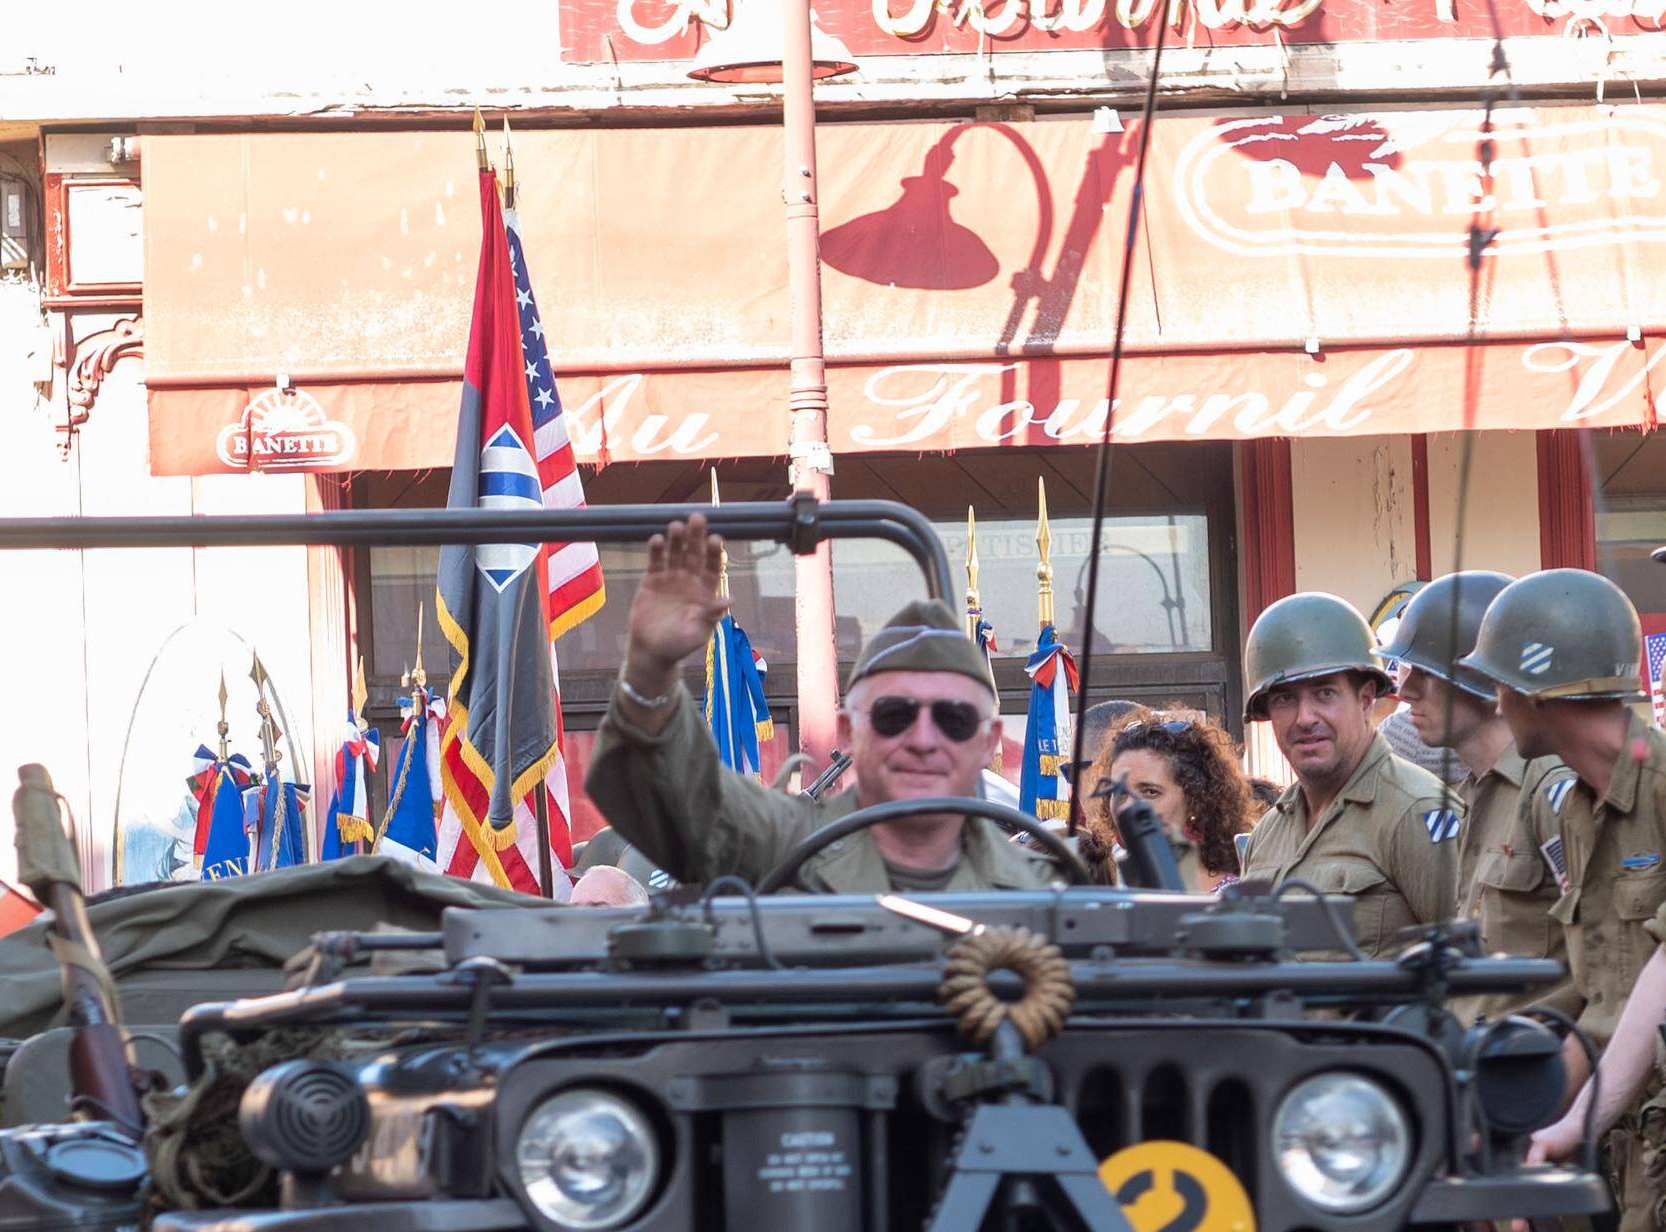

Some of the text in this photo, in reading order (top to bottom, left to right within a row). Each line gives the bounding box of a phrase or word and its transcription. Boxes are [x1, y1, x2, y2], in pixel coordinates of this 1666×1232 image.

[1241, 145, 1661, 216] BANETTE
[558, 373, 721, 455] Au
[850, 349, 1414, 448] Fournil
[233, 434, 338, 455] BANETTE
